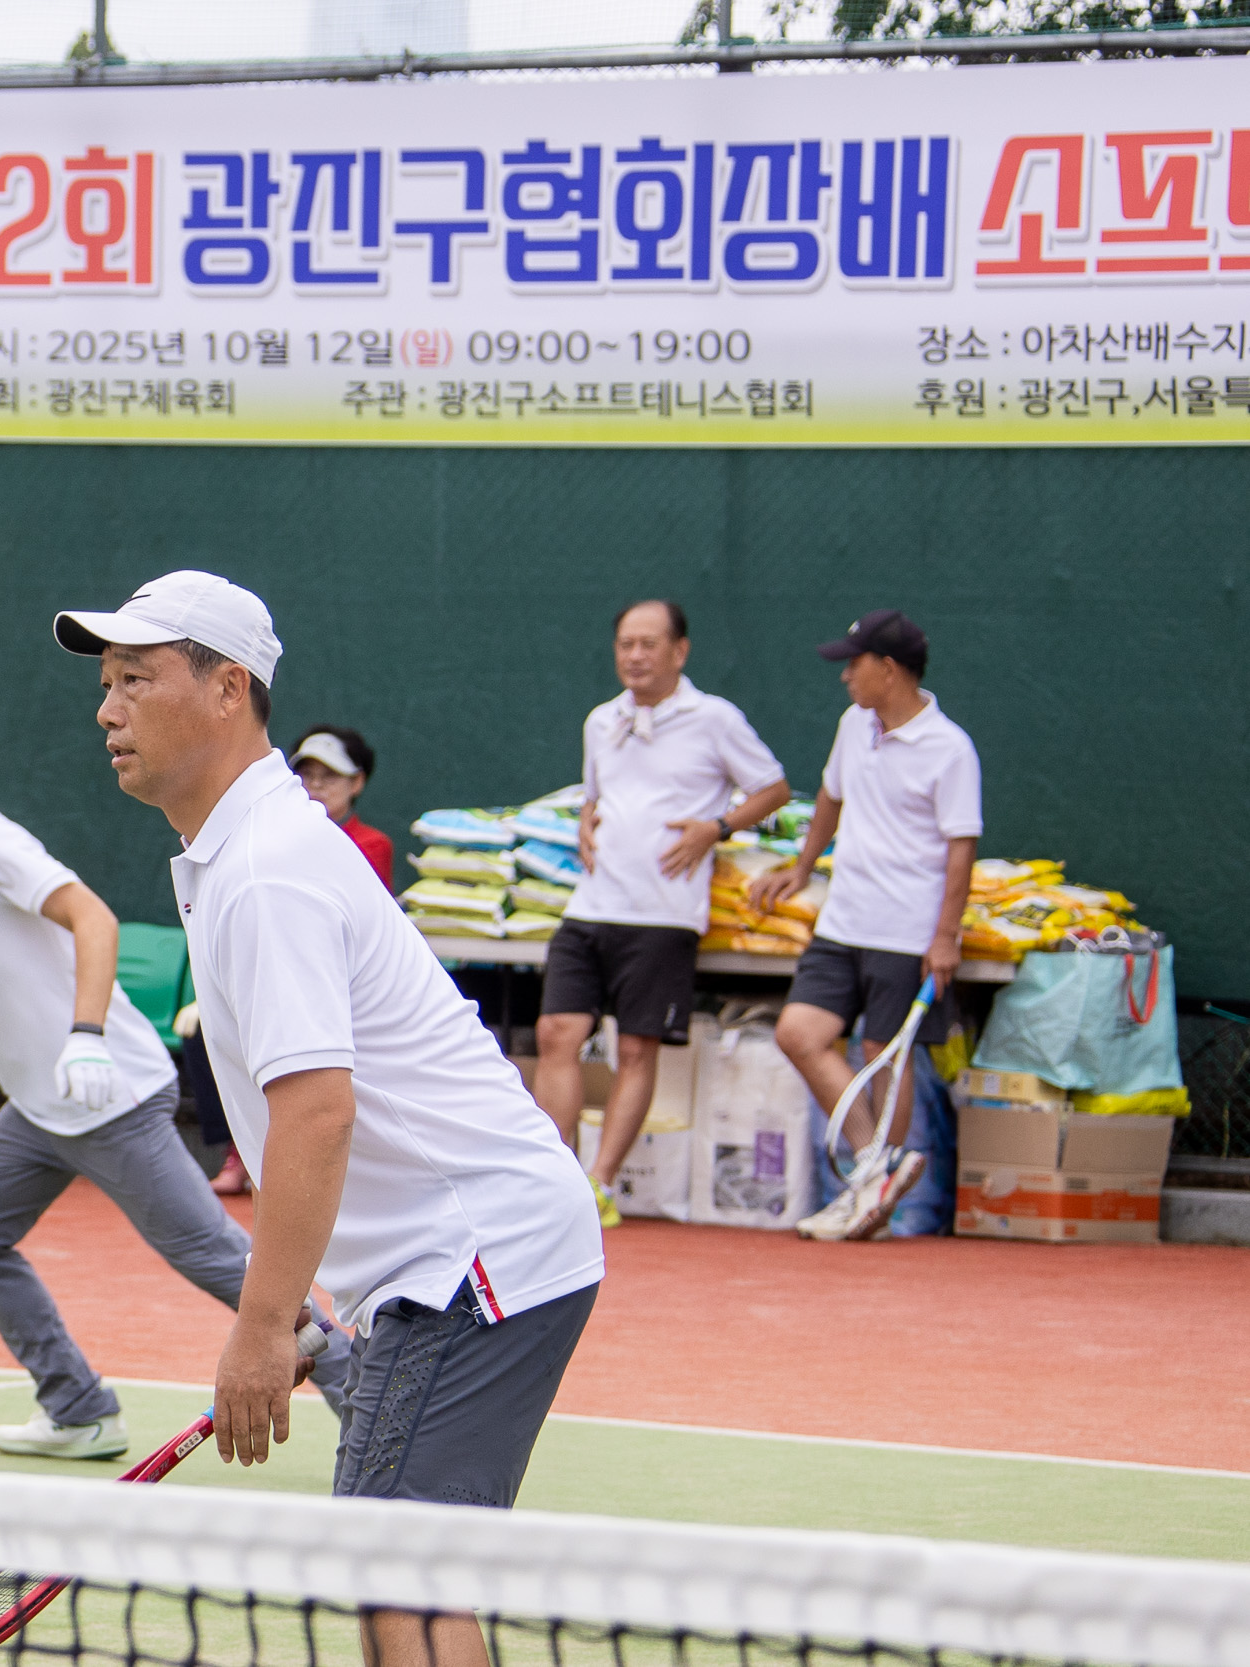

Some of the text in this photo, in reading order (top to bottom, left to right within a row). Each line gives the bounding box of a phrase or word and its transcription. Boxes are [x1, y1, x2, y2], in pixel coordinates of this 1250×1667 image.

[181, 136, 951, 285] 광진구협회장배
[48, 328, 187, 367] 2025년
[203, 327, 291, 369] 10월
[466, 328, 752, 366] 09:00~19:00
[1021, 319, 1250, 364] 아차산배수지
[48, 377, 237, 418] 광진구체육회
[437, 378, 815, 420] 광진구소프트테니스협회
